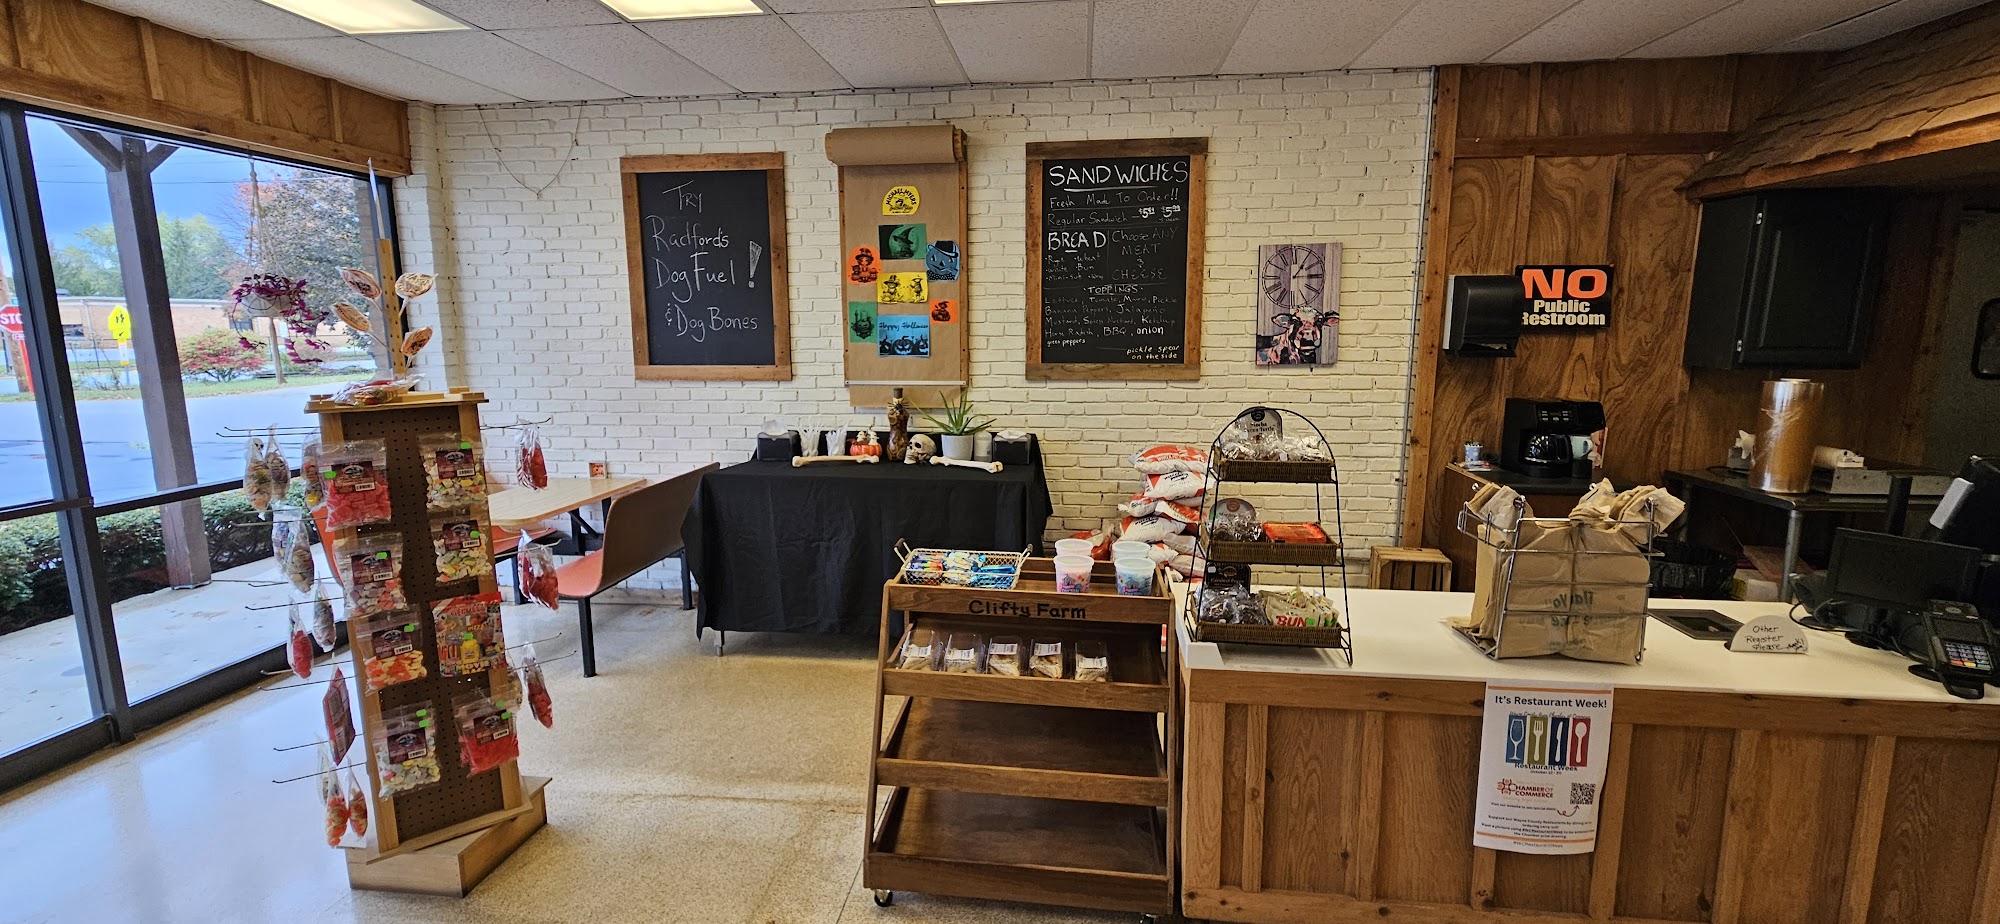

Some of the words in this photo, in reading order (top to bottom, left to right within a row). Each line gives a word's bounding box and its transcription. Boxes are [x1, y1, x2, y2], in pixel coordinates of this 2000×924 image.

[1050, 197, 1075, 208] Fresh
[1086, 194, 1111, 205] Made
[1116, 193, 1129, 202] To
[1048, 214, 1085, 231] Regular
[1089, 212, 1128, 224] Sandwich
[1048, 231, 1107, 250] BREAD
[1112, 230, 1149, 242] Choose
[1152, 227, 1178, 240] ANY
[1122, 243, 1161, 255] MEAT
[652, 256, 692, 303] Dog
[690, 252, 735, 292] Fuel
[1112, 268, 1168, 280] CHEESE
[1522, 268, 1608, 299] NO
[1088, 286, 1138, 295] TOPPINGS
[1534, 299, 1590, 312] Public
[674, 304, 705, 342] Dog
[707, 306, 758, 330] Bones
[879, 322, 900, 331] Happy
[1141, 315, 1176, 326] Ketchup
[1136, 326, 1164, 335] onion
[1062, 338, 1086, 347] peppers
[1126, 346, 1152, 355] pickle
[968, 600, 1030, 618] Clifty
[1036, 602, 1086, 619] Farm
[1753, 624, 1780, 633] Other
[1745, 635, 1784, 645] Register
[1495, 696, 1511, 704] It's
[1514, 696, 1572, 707] Restaurant
[1576, 699, 1607, 708] Week!
